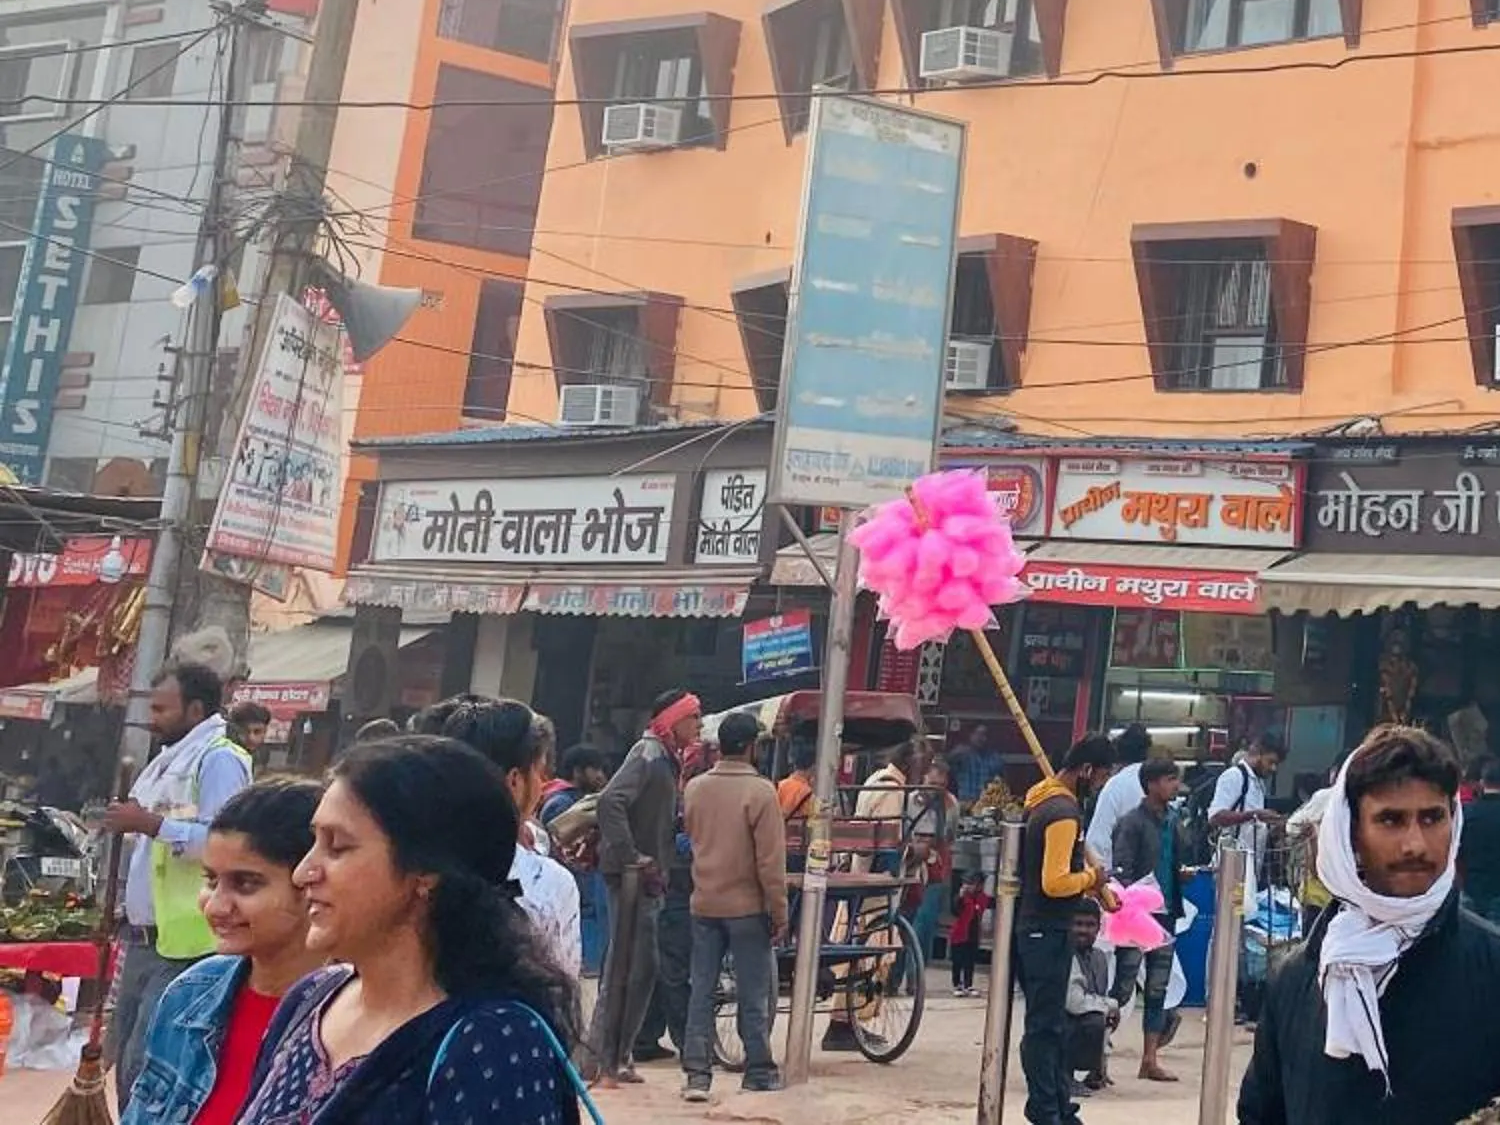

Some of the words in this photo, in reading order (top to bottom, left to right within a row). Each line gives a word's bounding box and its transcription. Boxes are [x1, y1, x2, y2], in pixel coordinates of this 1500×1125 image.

[53, 172, 92, 190] HOTEL
[12, 196, 81, 435] SETHIS
[721, 474, 756, 513] पंडित
[1120, 490, 1214, 541] मथुरा
[1220, 485, 1294, 532] वाले
[1317, 472, 1425, 536] मोहन
[1432, 472, 1485, 536] जी
[422, 488, 495, 554] मोती
[500, 508, 576, 554] वाला
[581, 487, 665, 554] भोज
[700, 518, 731, 555] मोती
[1116, 576, 1189, 603] मथुरा
[1198, 576, 1257, 602] वाले
